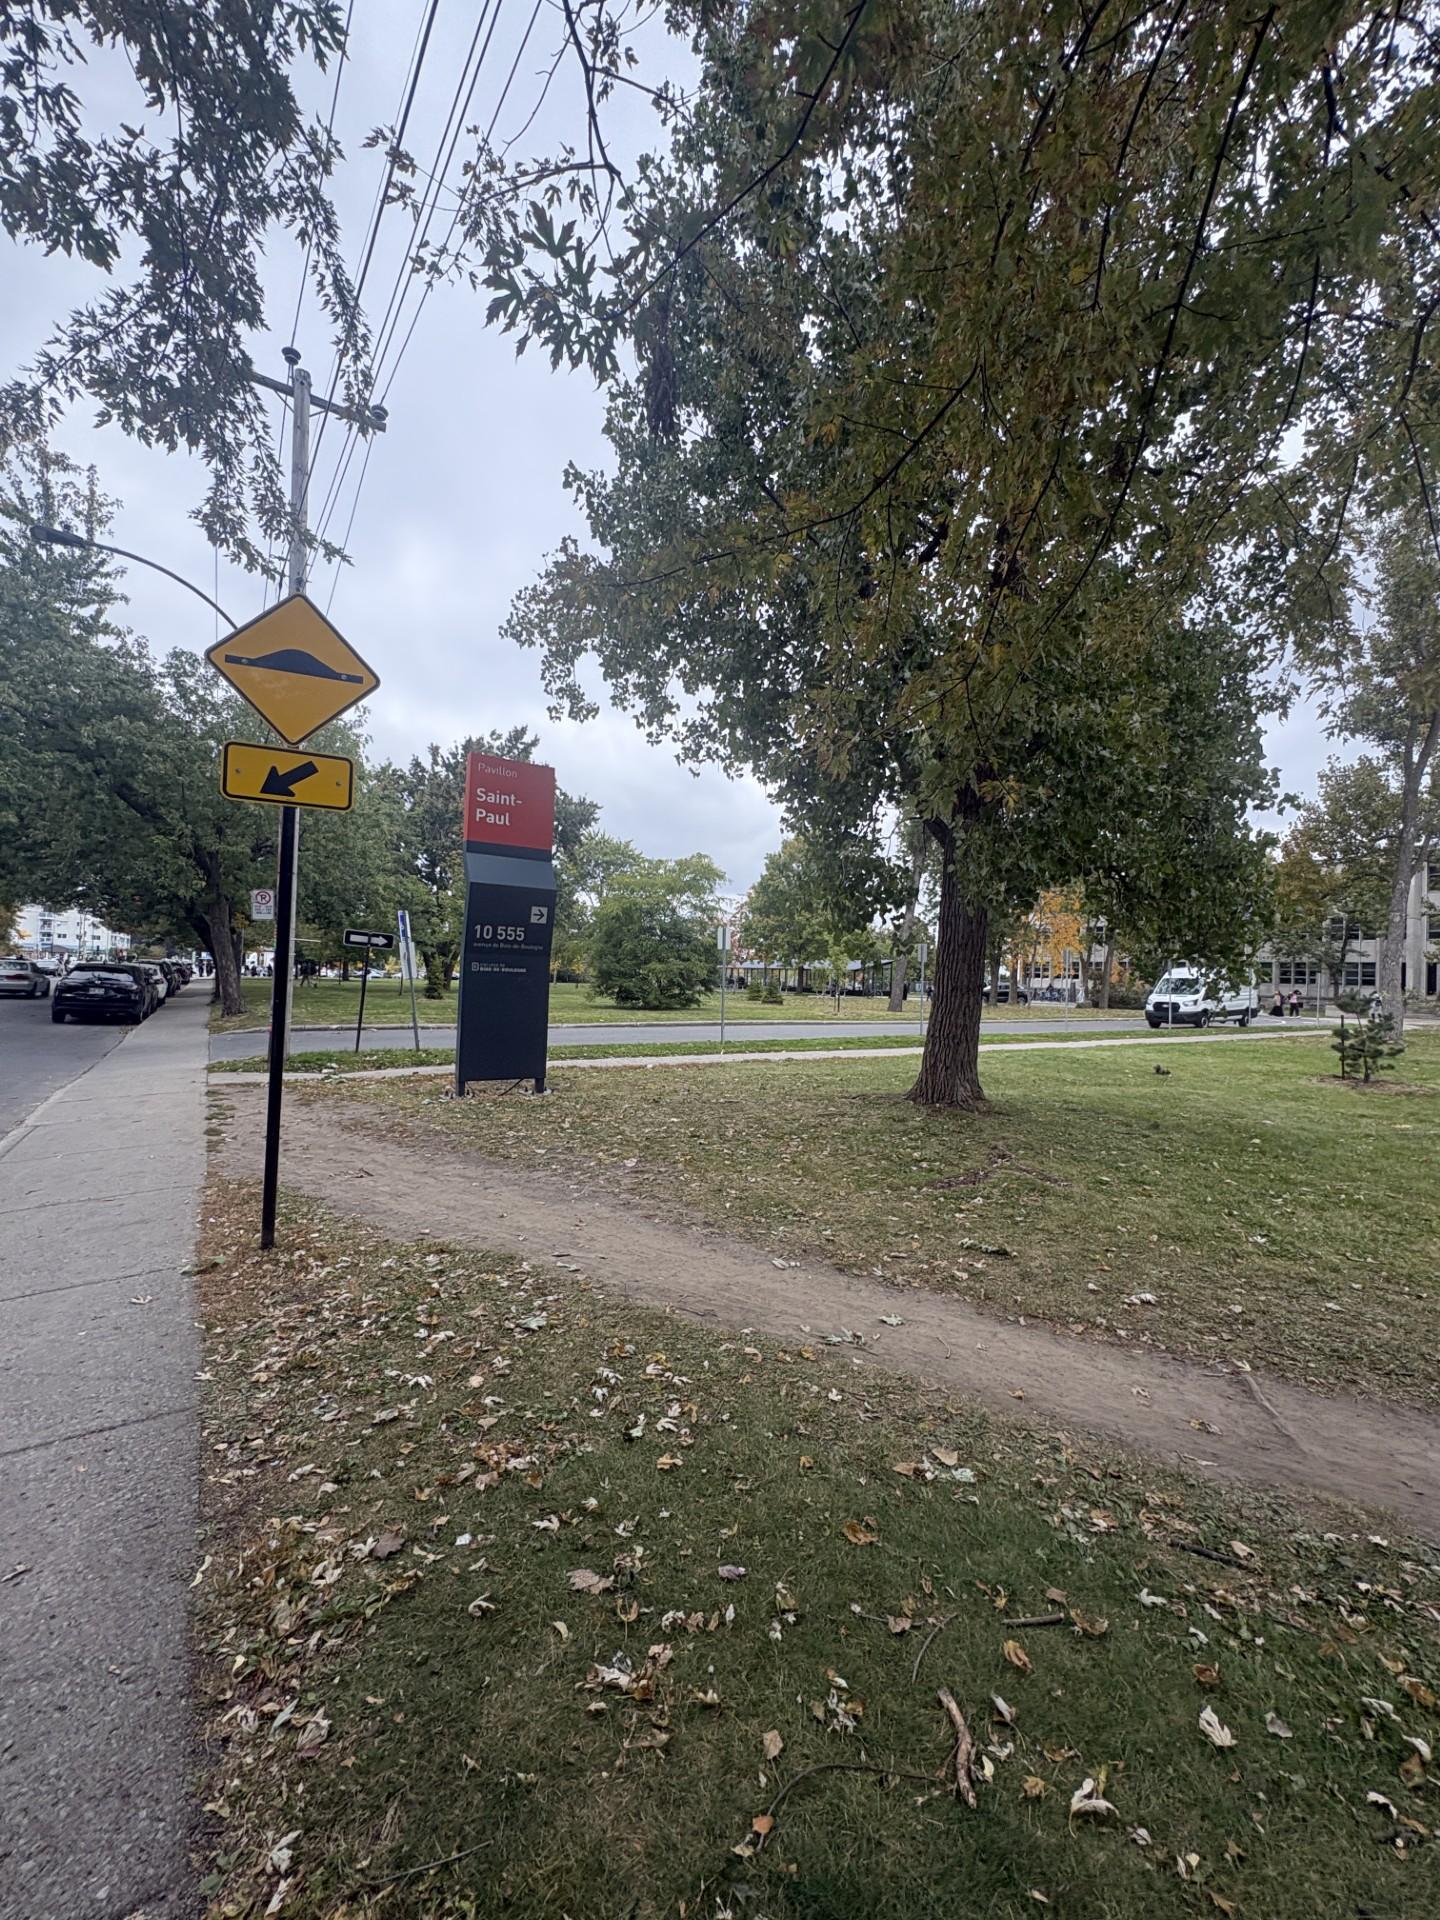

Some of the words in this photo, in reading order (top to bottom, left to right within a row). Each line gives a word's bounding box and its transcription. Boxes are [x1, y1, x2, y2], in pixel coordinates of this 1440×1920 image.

[478, 762, 518, 778] Pavillon
[476, 787, 523, 806] Saint-
[475, 808, 511, 826] Paul
[474, 924, 493, 940] 10
[496, 926, 525, 941] 555
